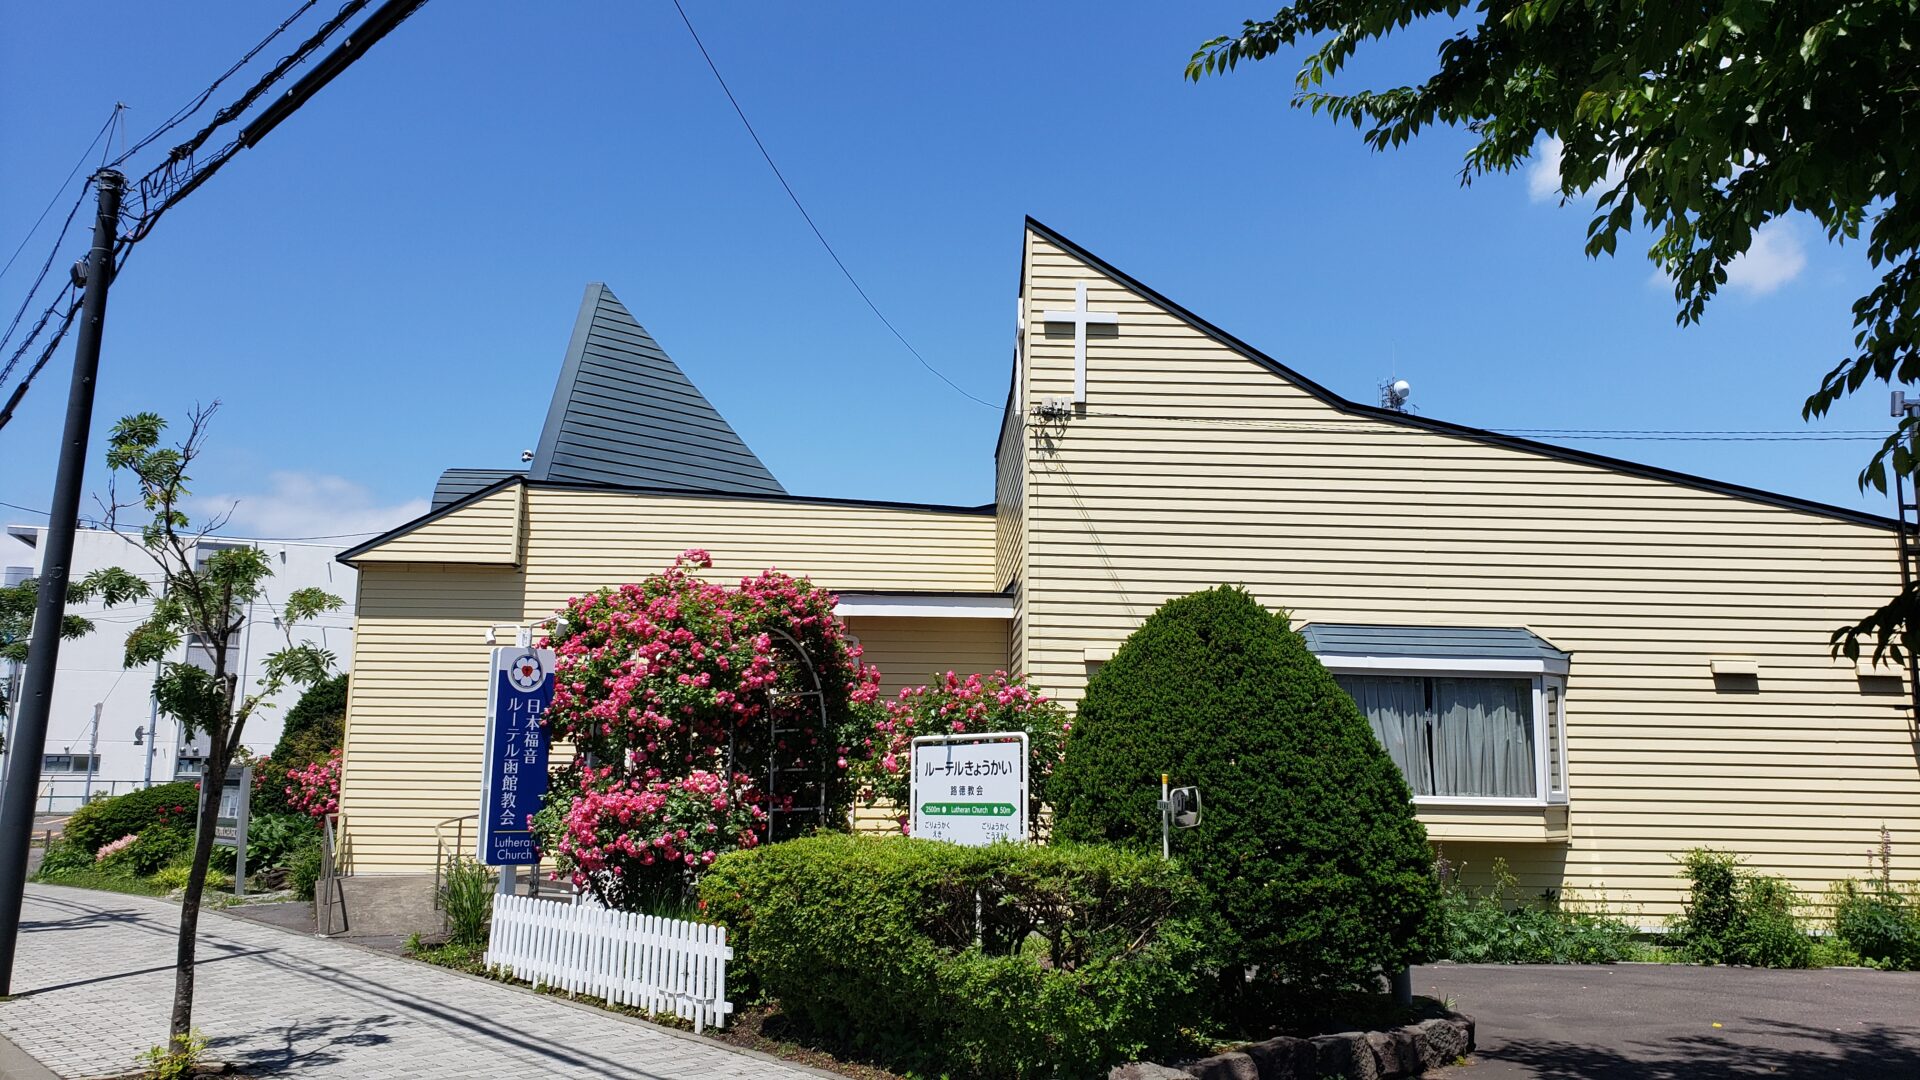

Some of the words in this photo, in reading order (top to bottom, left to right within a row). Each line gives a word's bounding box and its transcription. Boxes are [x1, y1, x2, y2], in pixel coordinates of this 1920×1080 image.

[523, 699, 542, 764] 日本福音
[500, 697, 524, 826] ルーテル函館教会
[924, 760, 1013, 777] ルーテルきょうかい
[950, 785, 984, 796] 路徳教会
[971, 806, 989, 814] Church
[924, 821, 950, 830] ごりょうかく
[981, 822, 1010, 831] ごりょうかく
[494, 836, 536, 848] Lutheran
[497, 848, 532, 860] Church
